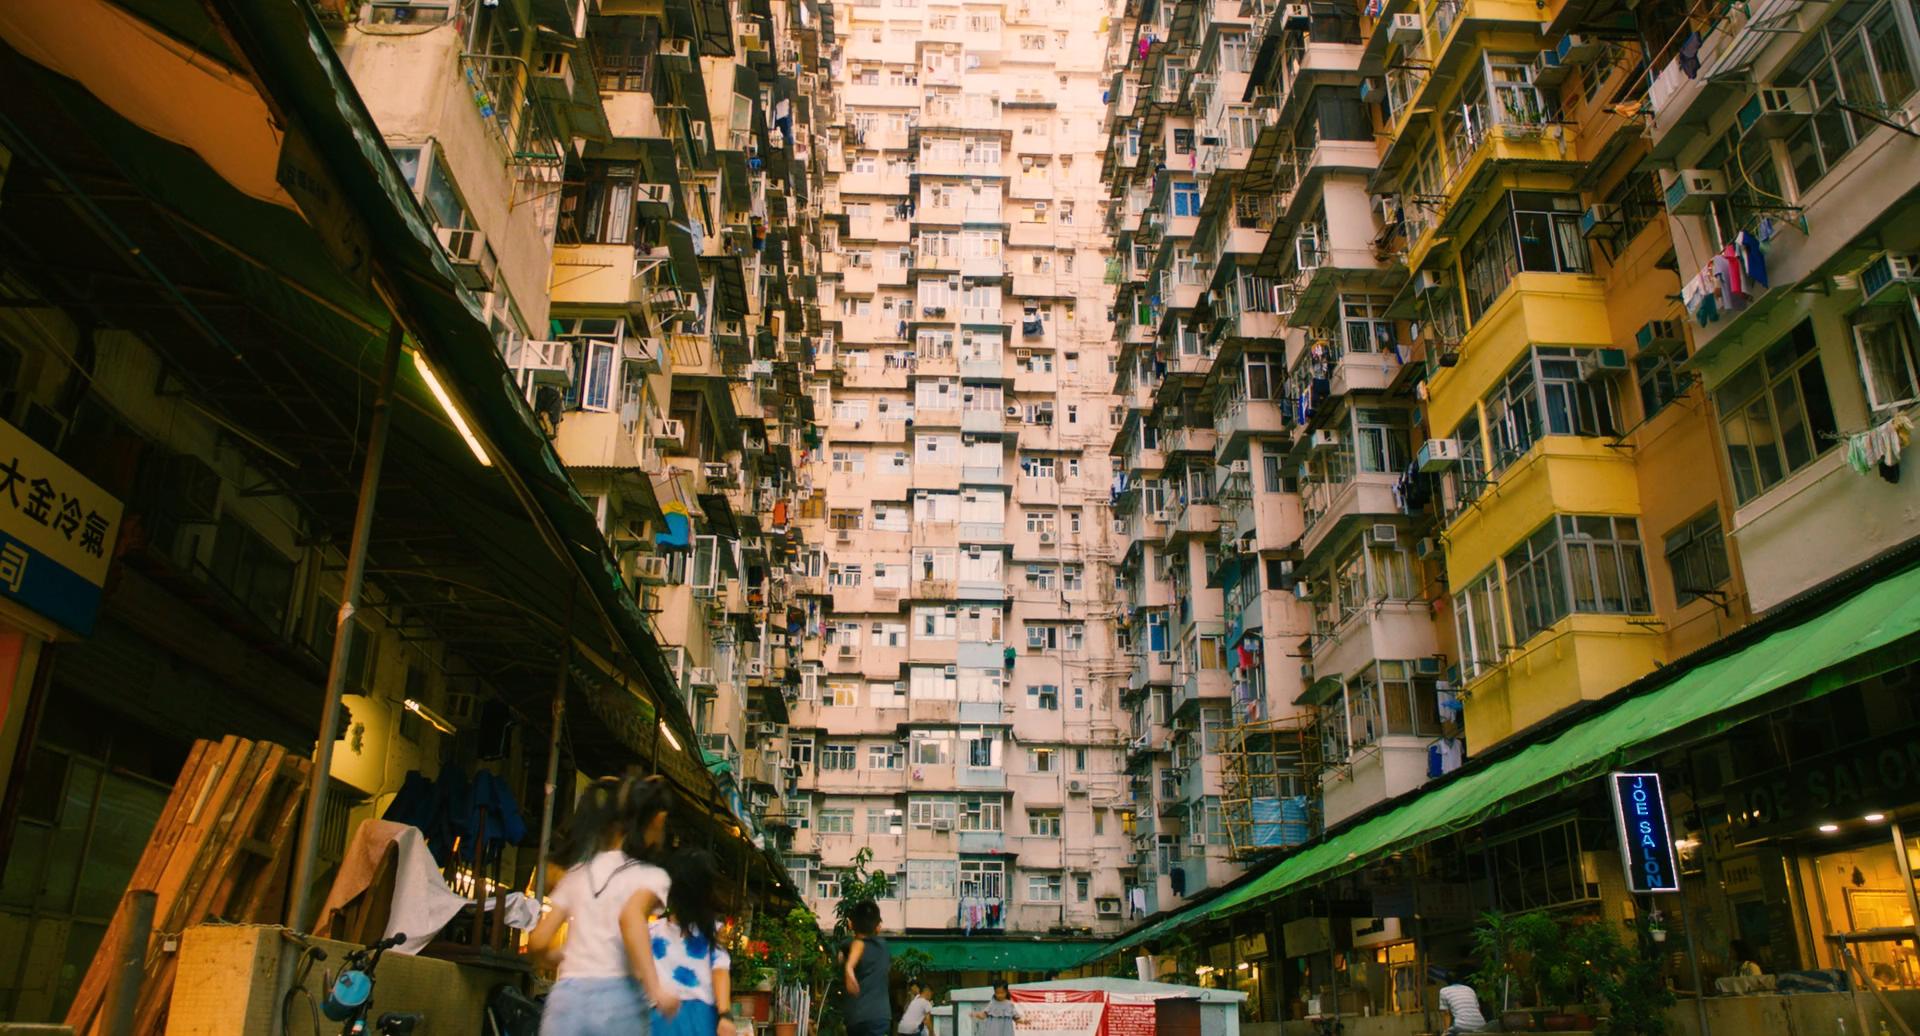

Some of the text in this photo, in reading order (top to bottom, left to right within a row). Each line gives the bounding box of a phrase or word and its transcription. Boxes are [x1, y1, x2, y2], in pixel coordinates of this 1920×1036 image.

[0, 457, 109, 558] 大金冷氣
[1633, 776, 1663, 888] JOE SALON
